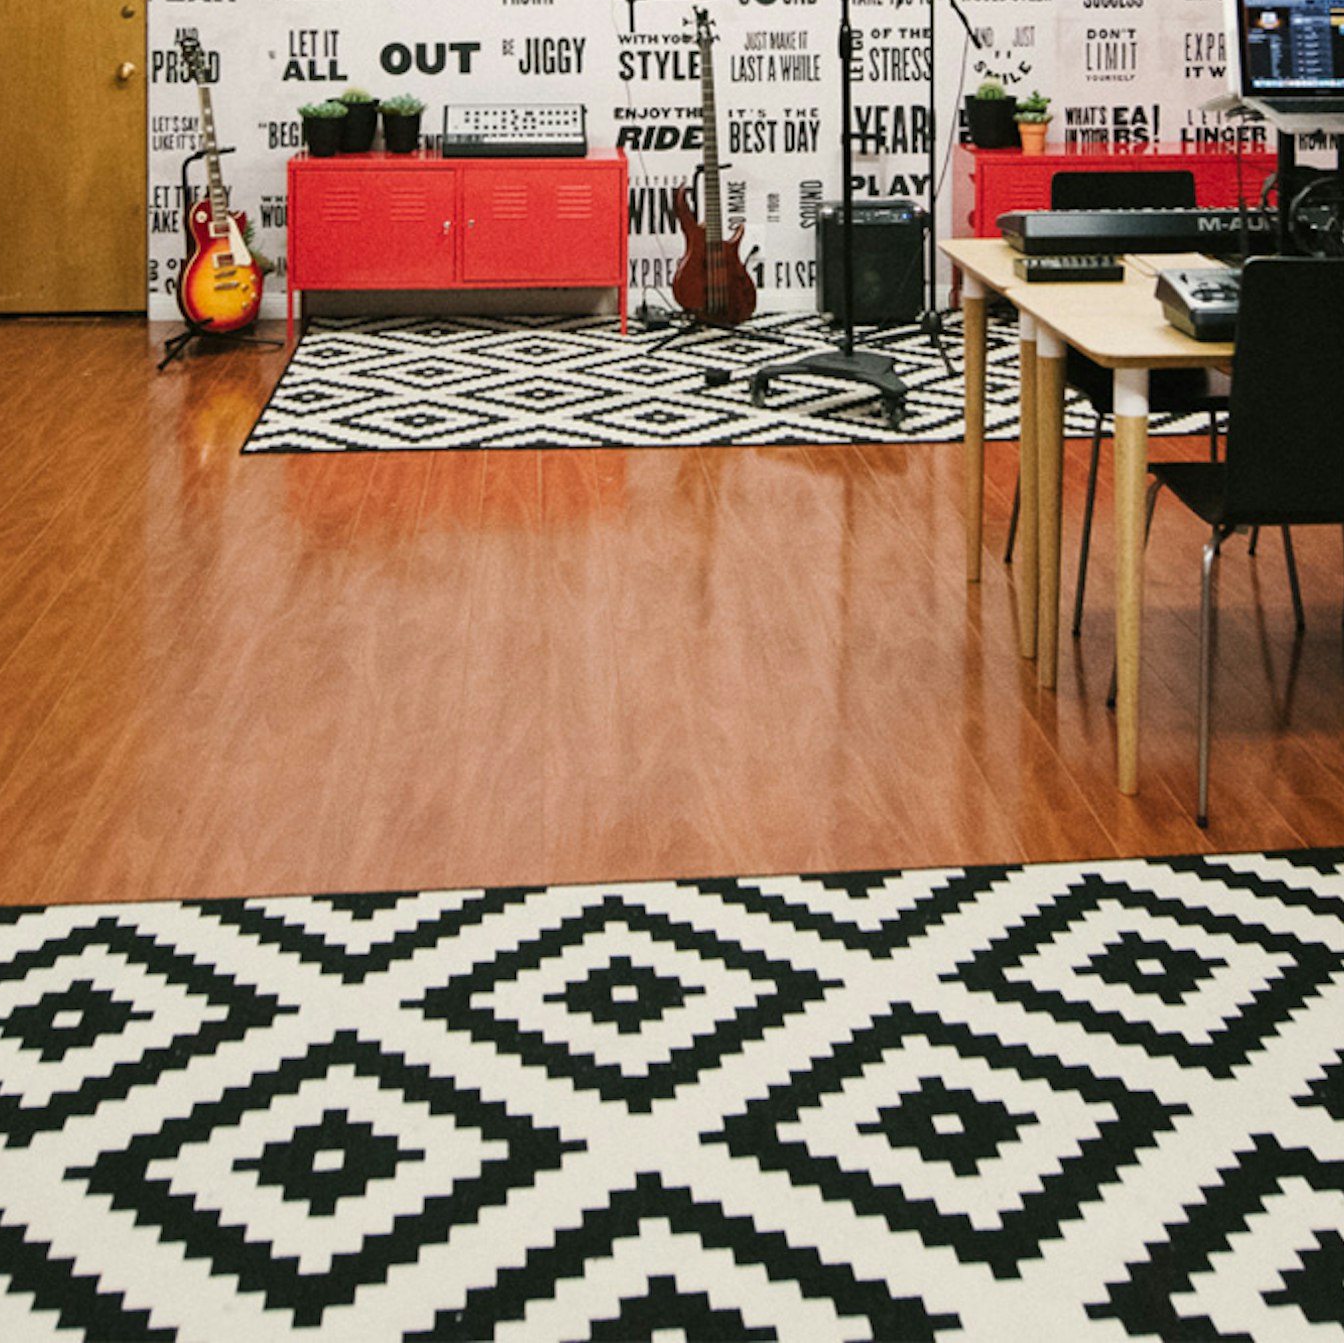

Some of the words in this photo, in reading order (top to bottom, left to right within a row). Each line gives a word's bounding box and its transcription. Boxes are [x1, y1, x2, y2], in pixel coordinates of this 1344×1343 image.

[379, 41, 482, 76] OUT
[518, 37, 586, 76] JIGGY
[729, 119, 778, 154] BEST
[784, 120, 821, 154] DAY
